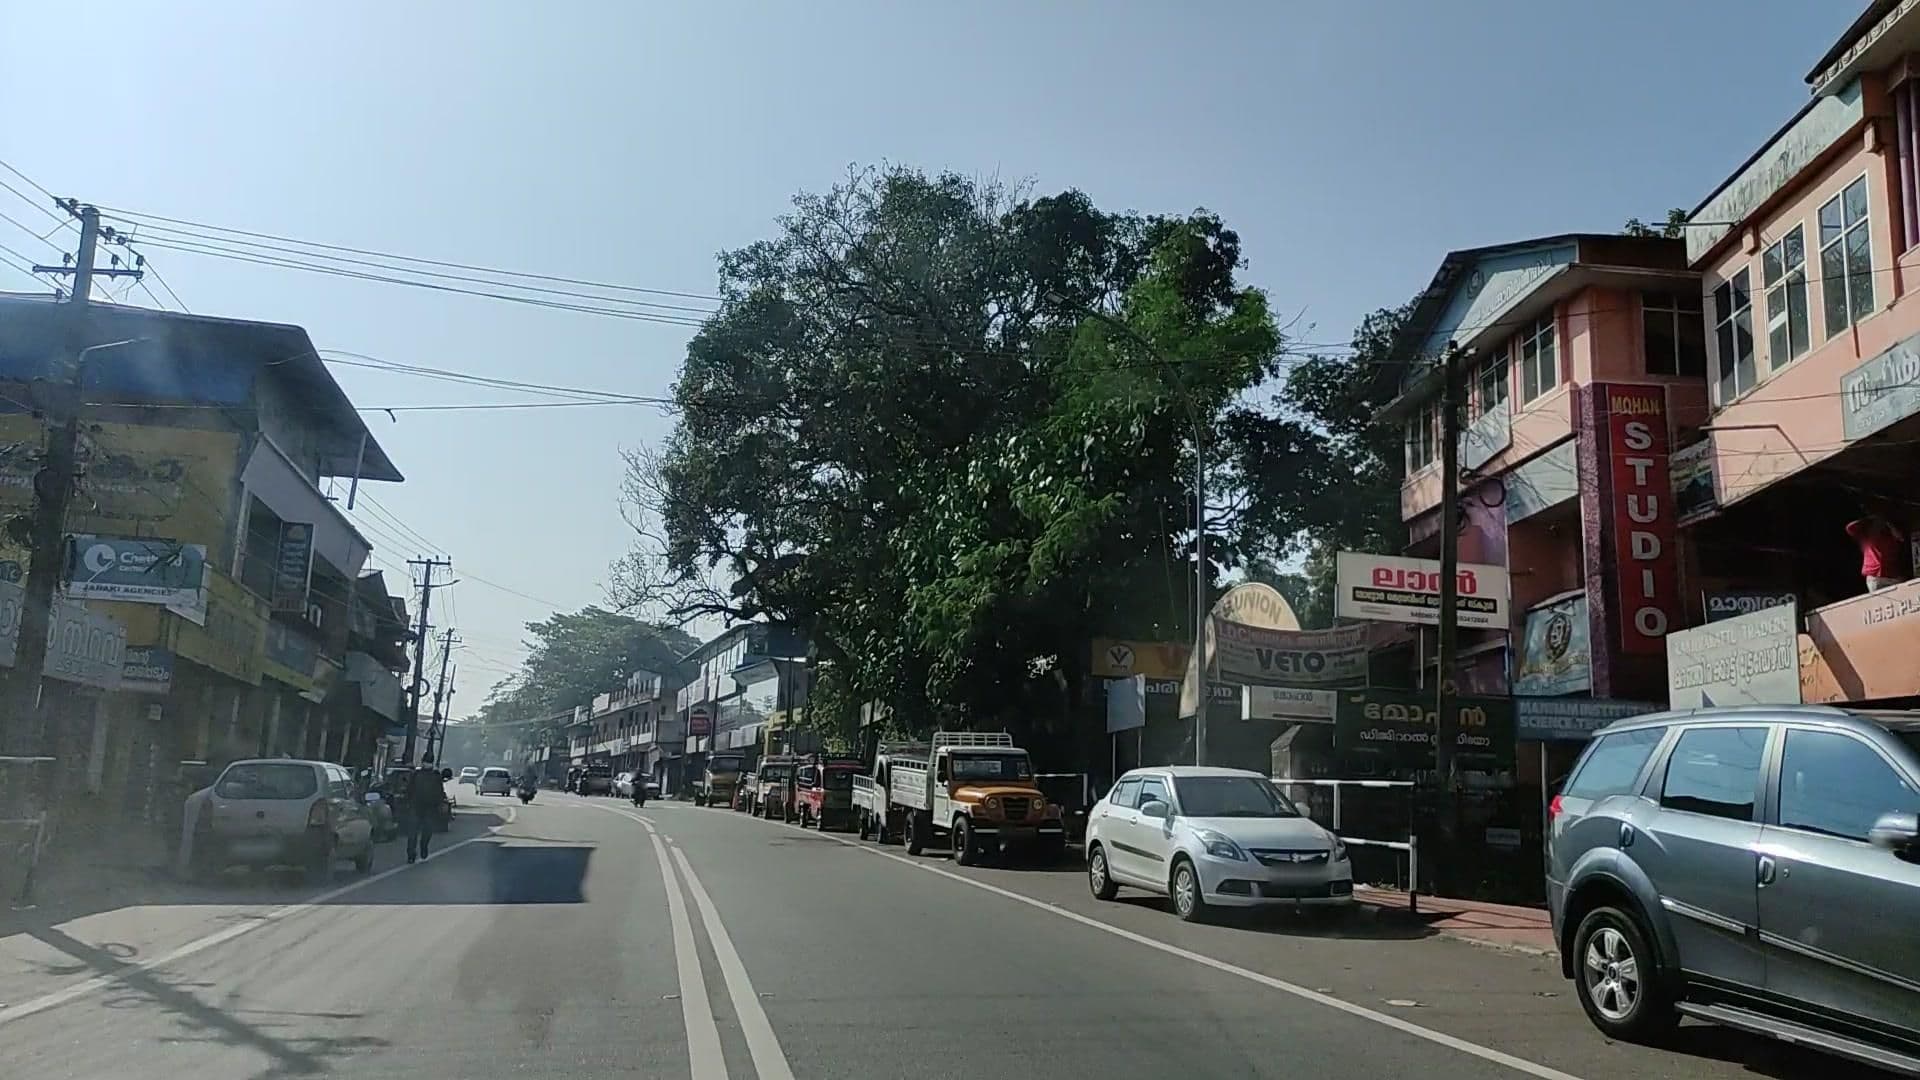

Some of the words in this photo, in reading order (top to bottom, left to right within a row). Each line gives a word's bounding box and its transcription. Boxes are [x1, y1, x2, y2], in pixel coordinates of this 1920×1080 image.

[1611, 396, 1661, 415] MOHAN
[1624, 422, 1668, 636] STUDIO
[1256, 647, 1326, 673] VETO
